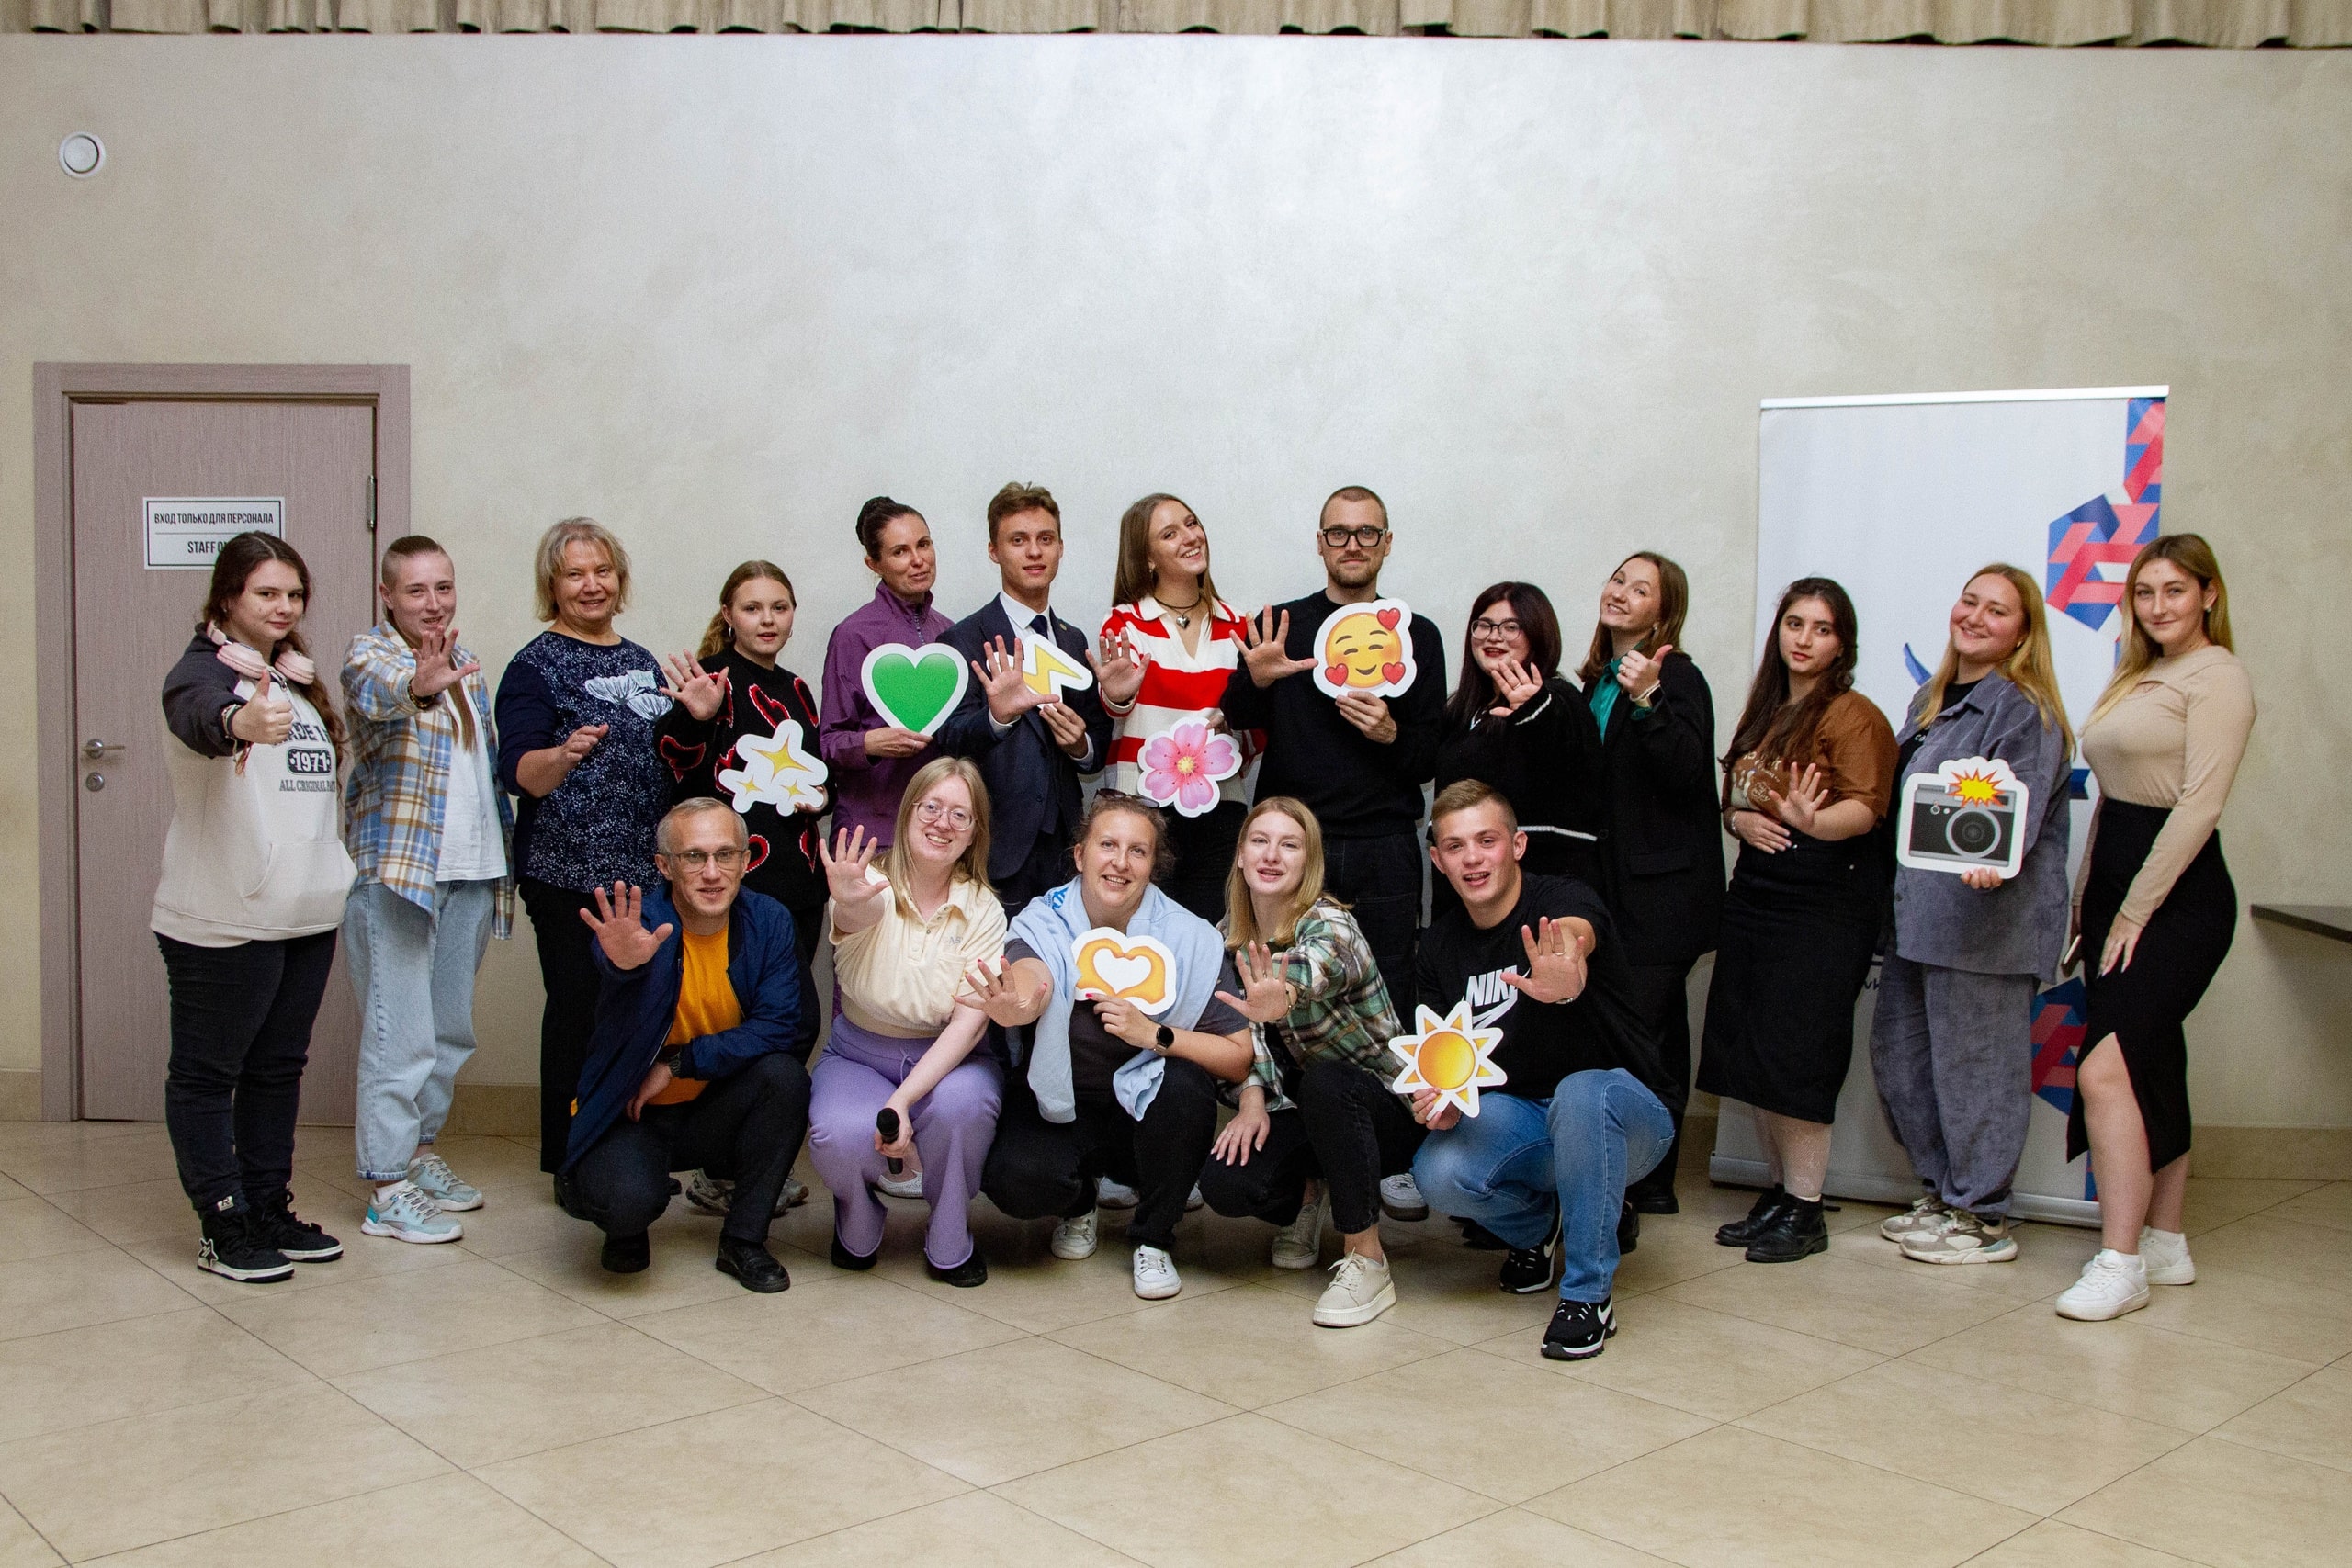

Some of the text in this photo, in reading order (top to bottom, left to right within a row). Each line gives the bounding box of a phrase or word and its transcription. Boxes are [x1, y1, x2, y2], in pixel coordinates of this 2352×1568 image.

[154, 513, 274, 525] ВХОД ТОЛЬКО ДЛЯ ПЕРСОНАЛА
[187, 541, 216, 554] STAFF
[284, 722, 318, 742] ADE
[293, 751, 328, 772] 1971
[279, 779, 297, 791] ALL
